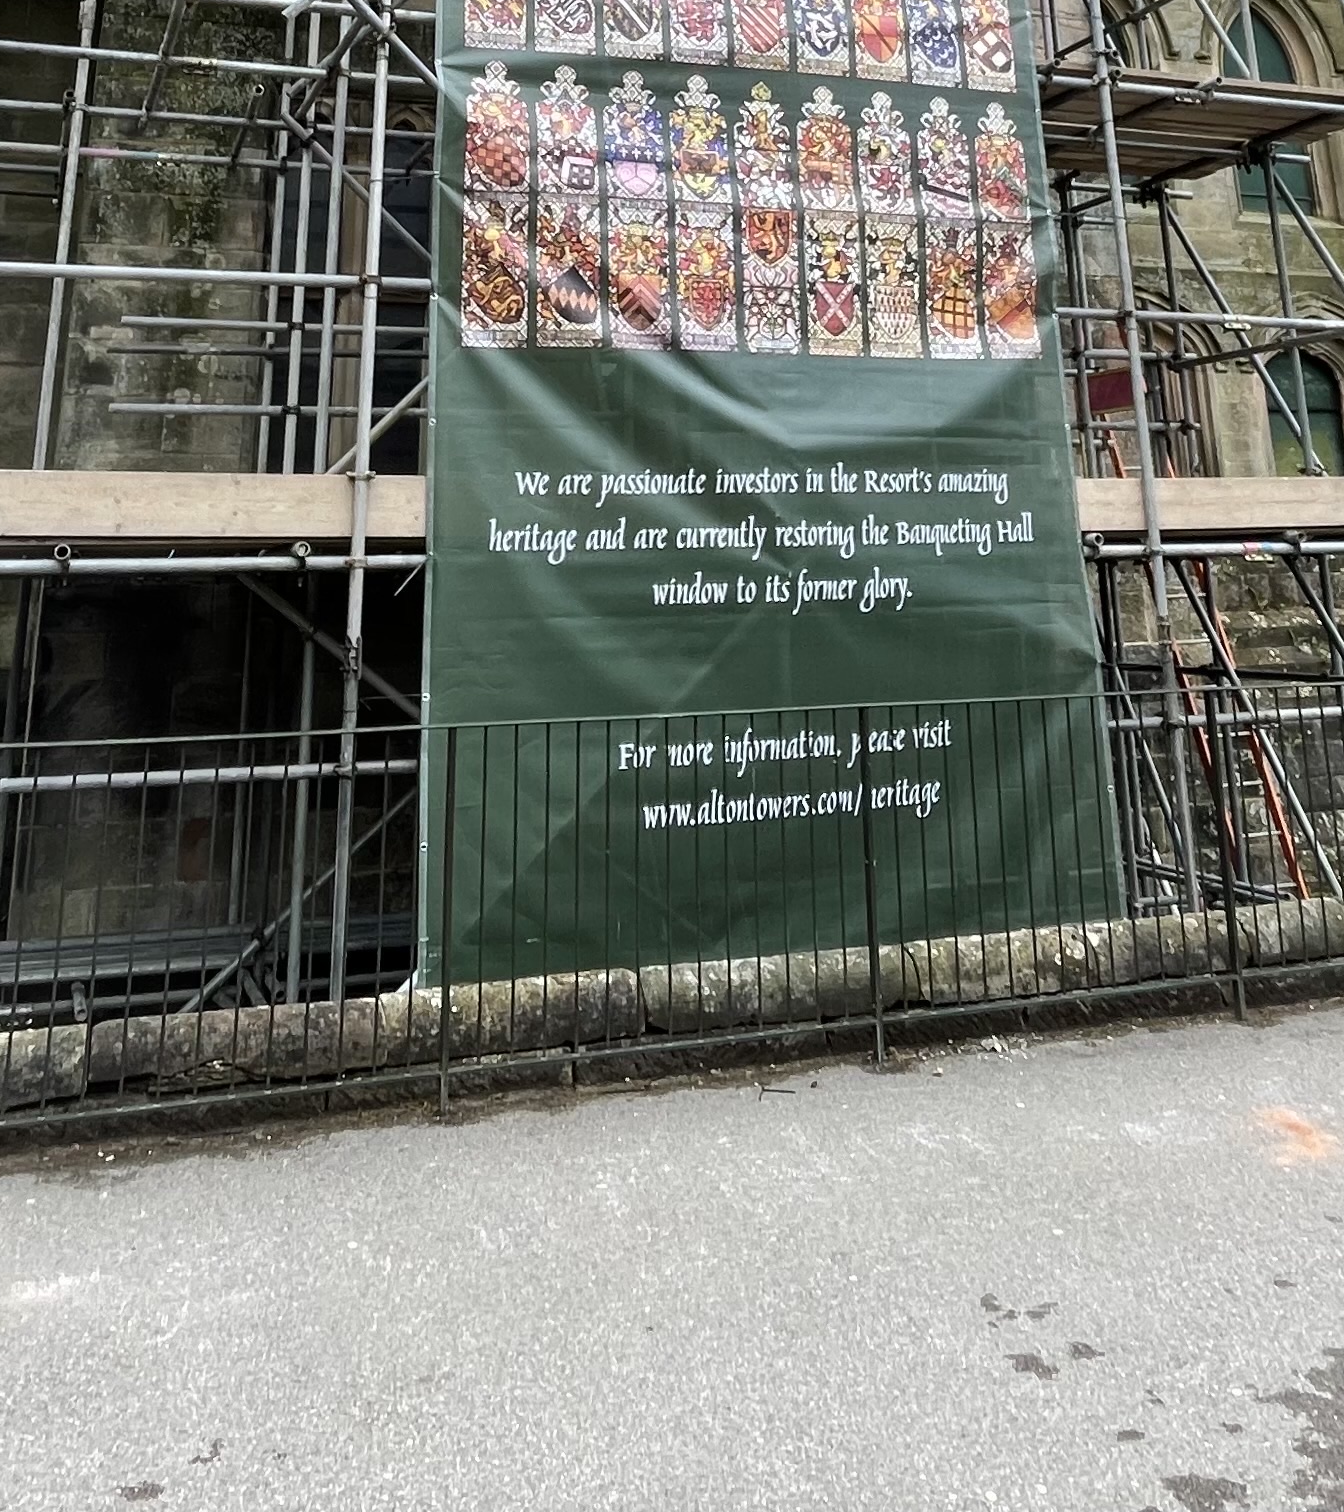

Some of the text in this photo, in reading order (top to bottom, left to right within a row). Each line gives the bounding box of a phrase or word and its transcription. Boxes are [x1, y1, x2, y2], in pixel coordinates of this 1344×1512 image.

[515, 462, 1008, 508] We are passionate investors in the Resort's amazing
[489, 512, 1035, 564] heritage and are currently restoring the Banqueting Hall
[652, 567, 913, 616] window to its former glory.
[618, 743, 657, 770] For
[668, 741, 714, 767] more
[847, 728, 906, 769] peae
[912, 719, 952, 749] visit
[643, 778, 941, 829] www.altontowers.com/eritage
